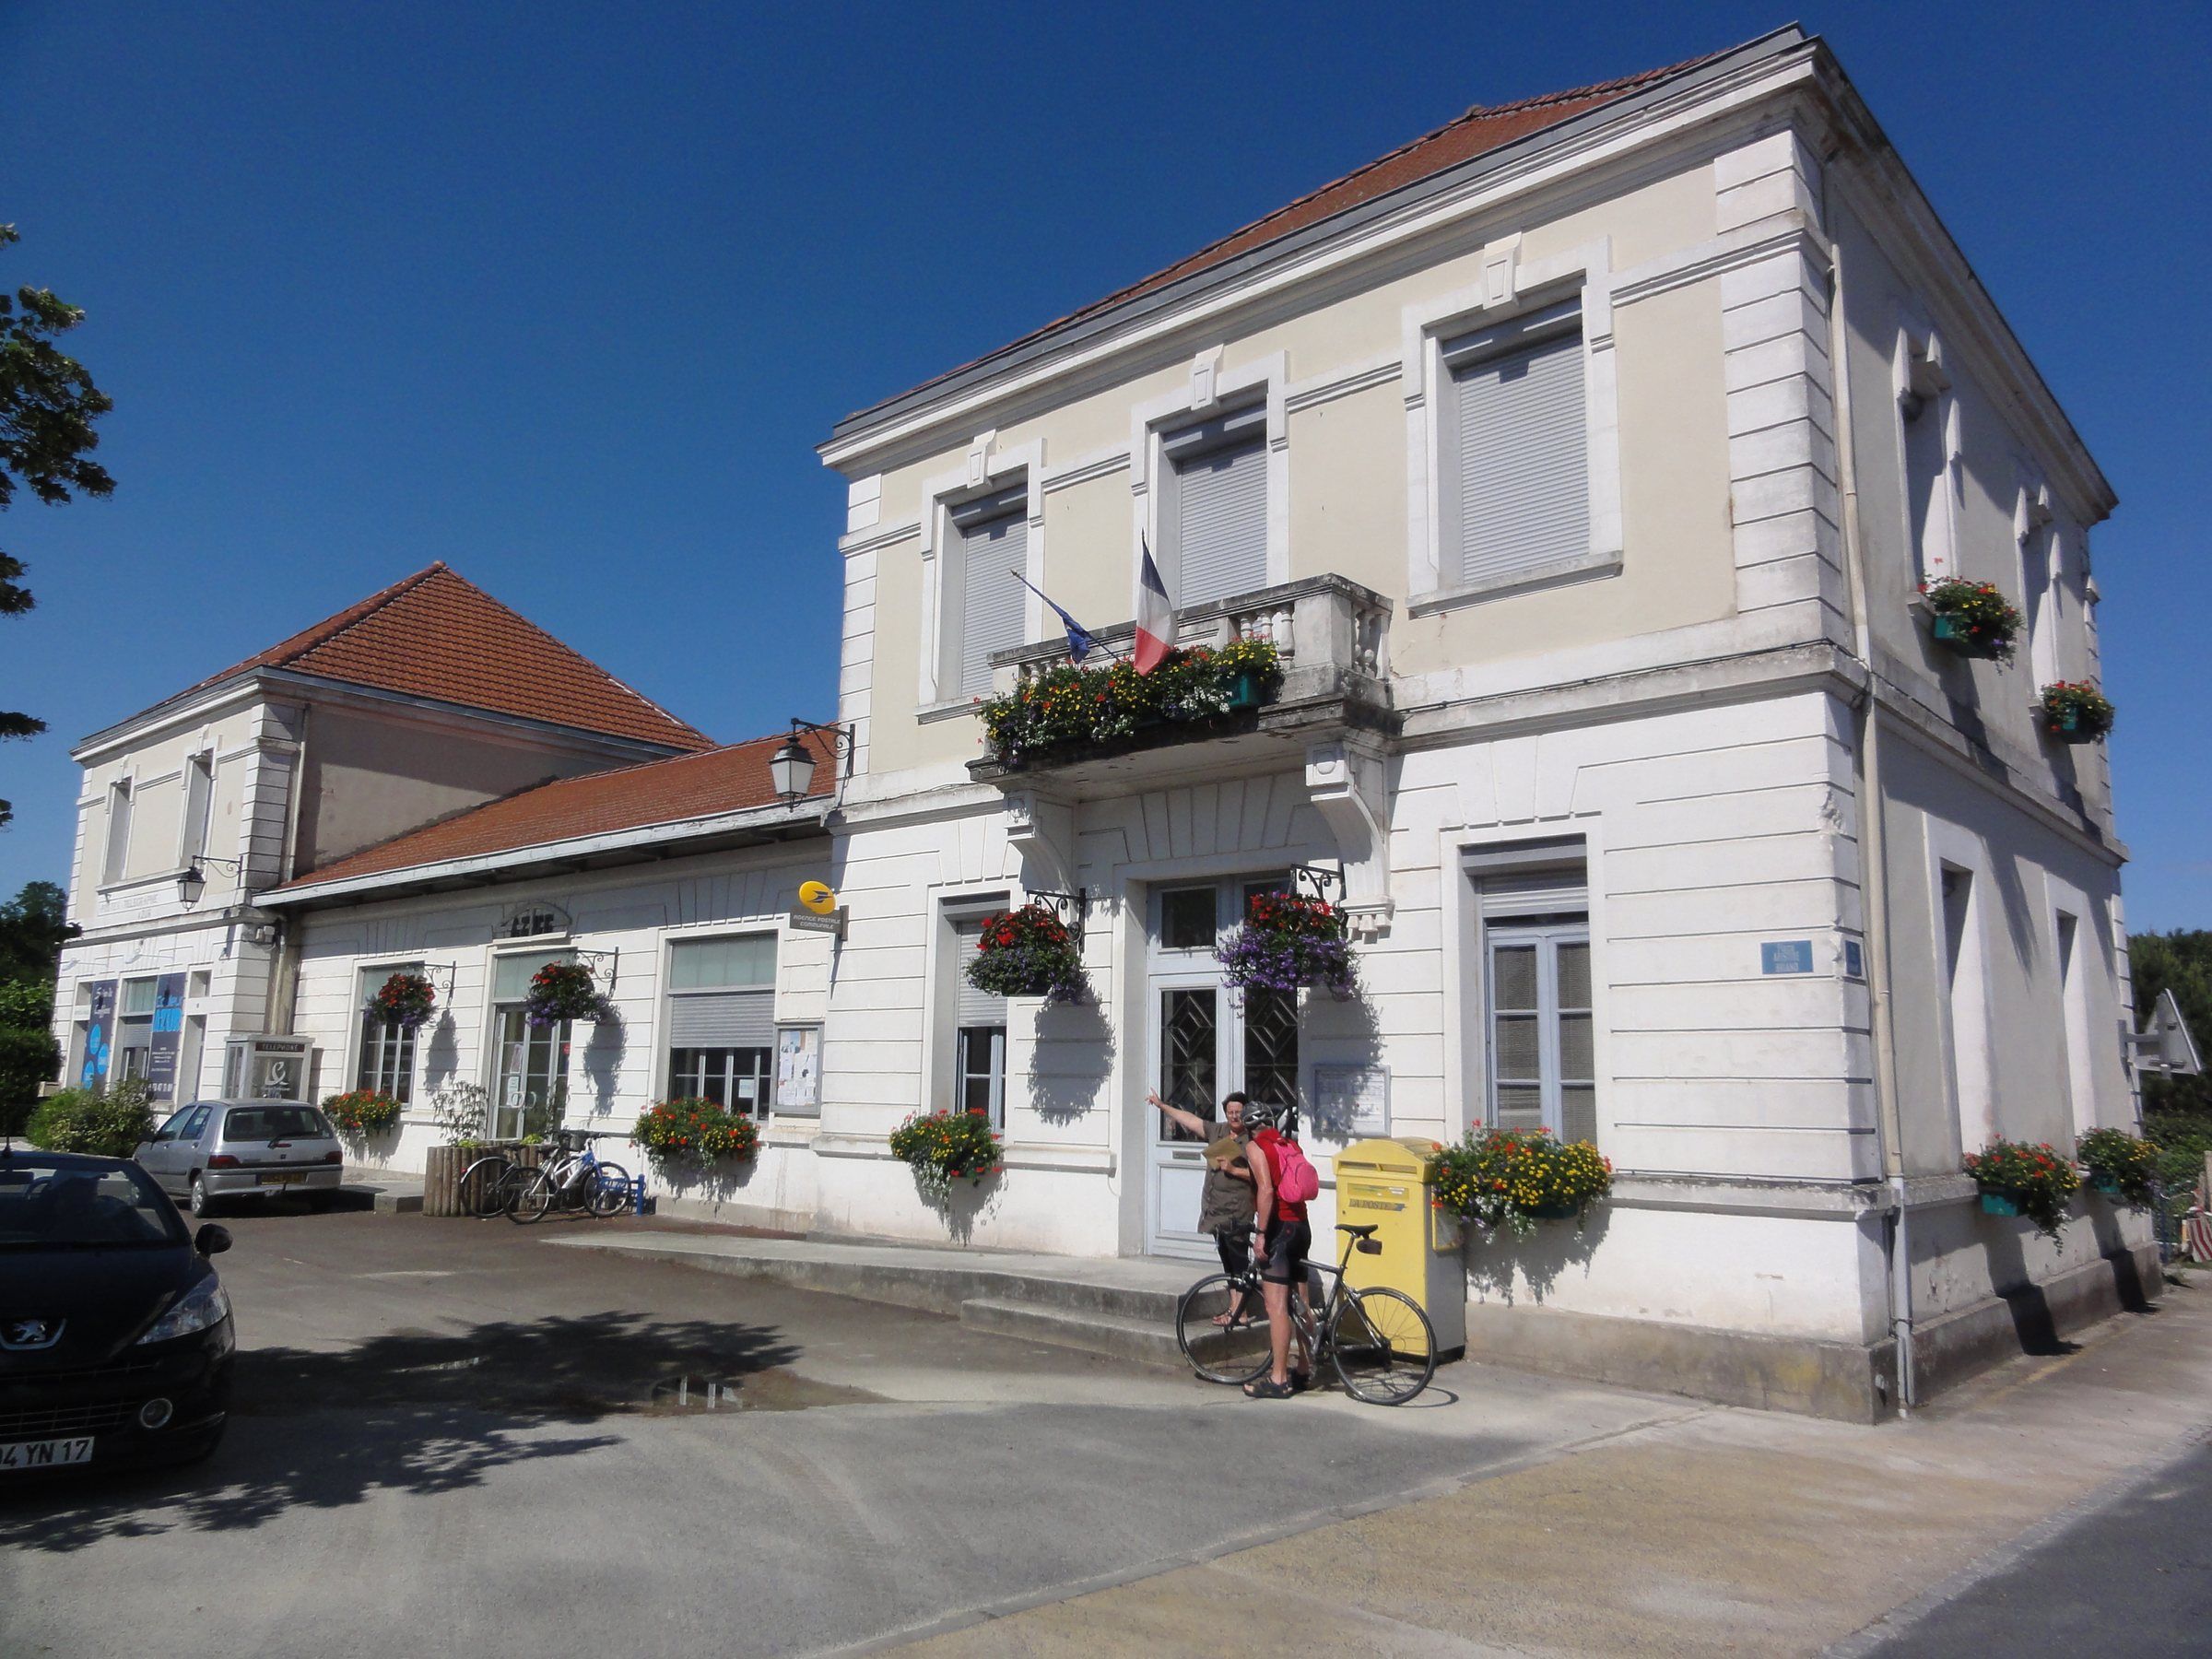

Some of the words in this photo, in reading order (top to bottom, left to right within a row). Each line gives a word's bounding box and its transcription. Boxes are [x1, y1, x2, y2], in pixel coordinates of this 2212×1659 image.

[1362, 1200, 1389, 1210] POSTE
[0, 1445, 18, 1466] 4
[26, 1442, 55, 1465] YN
[64, 1439, 90, 1461] 17
